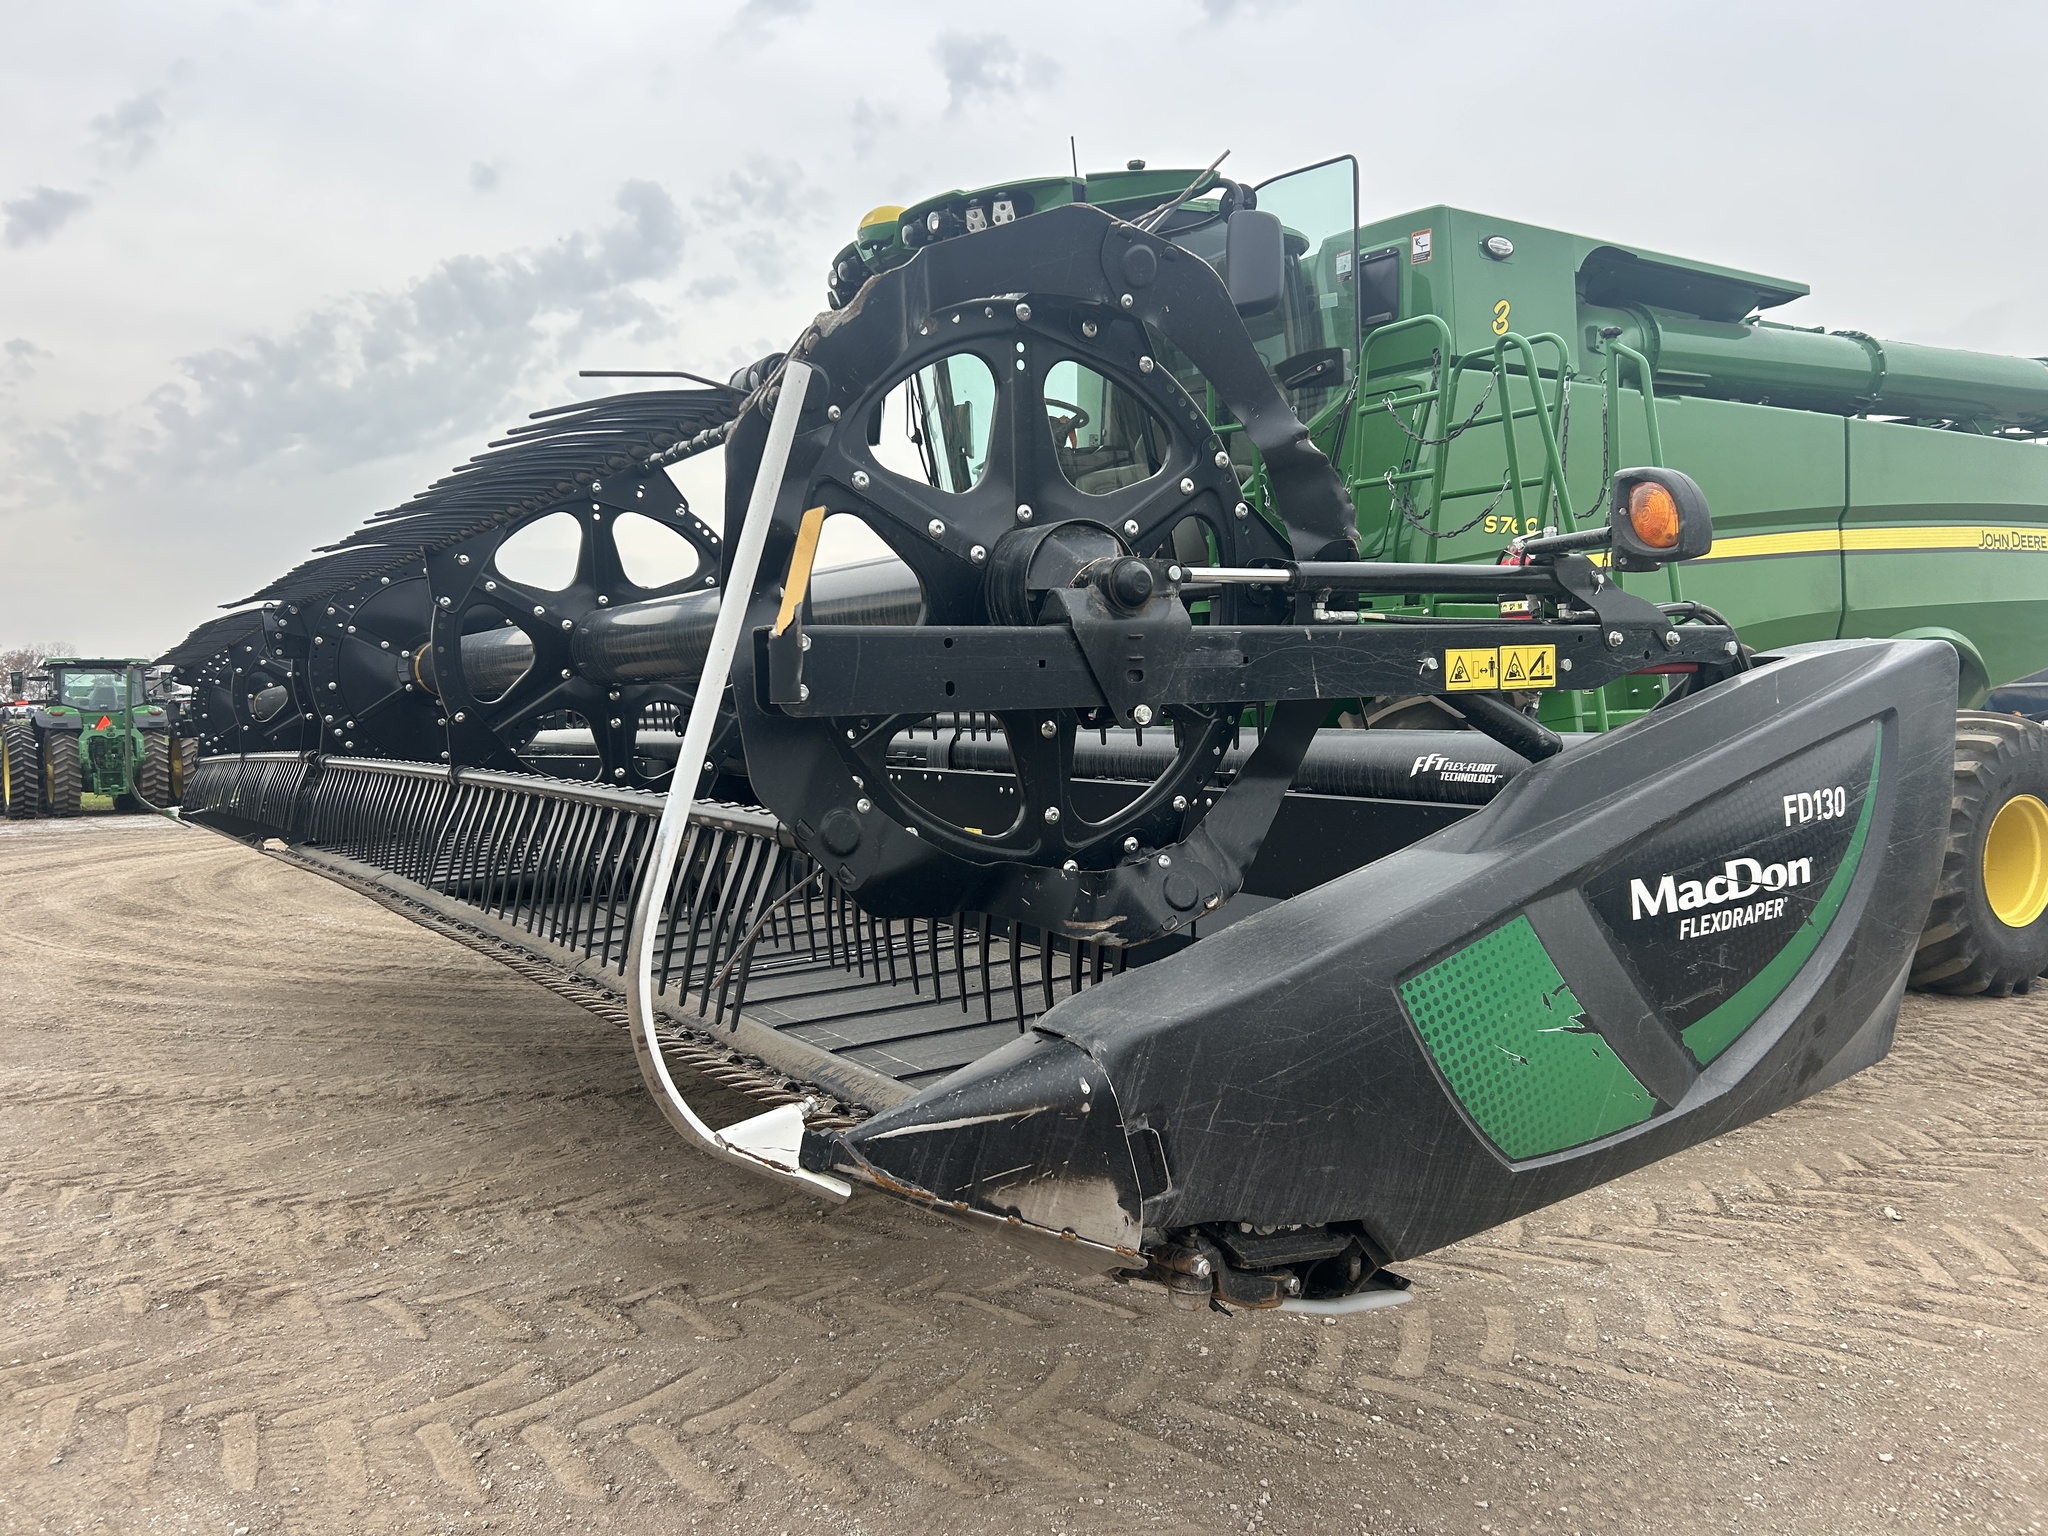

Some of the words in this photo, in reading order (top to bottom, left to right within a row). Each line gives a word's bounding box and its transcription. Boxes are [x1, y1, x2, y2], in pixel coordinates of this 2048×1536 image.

[1492, 299, 1511, 336] 3
[1979, 530, 2010, 548] JOHN
[2011, 531, 2048, 549] DEERE
[1410, 753, 1449, 778] FFT
[1443, 761, 1498, 773] FLEX-FLOAT
[1783, 786, 1846, 827] FD130
[1630, 857, 1812, 921] MacDon
[1679, 897, 1784, 941] FLEXDRAPER
